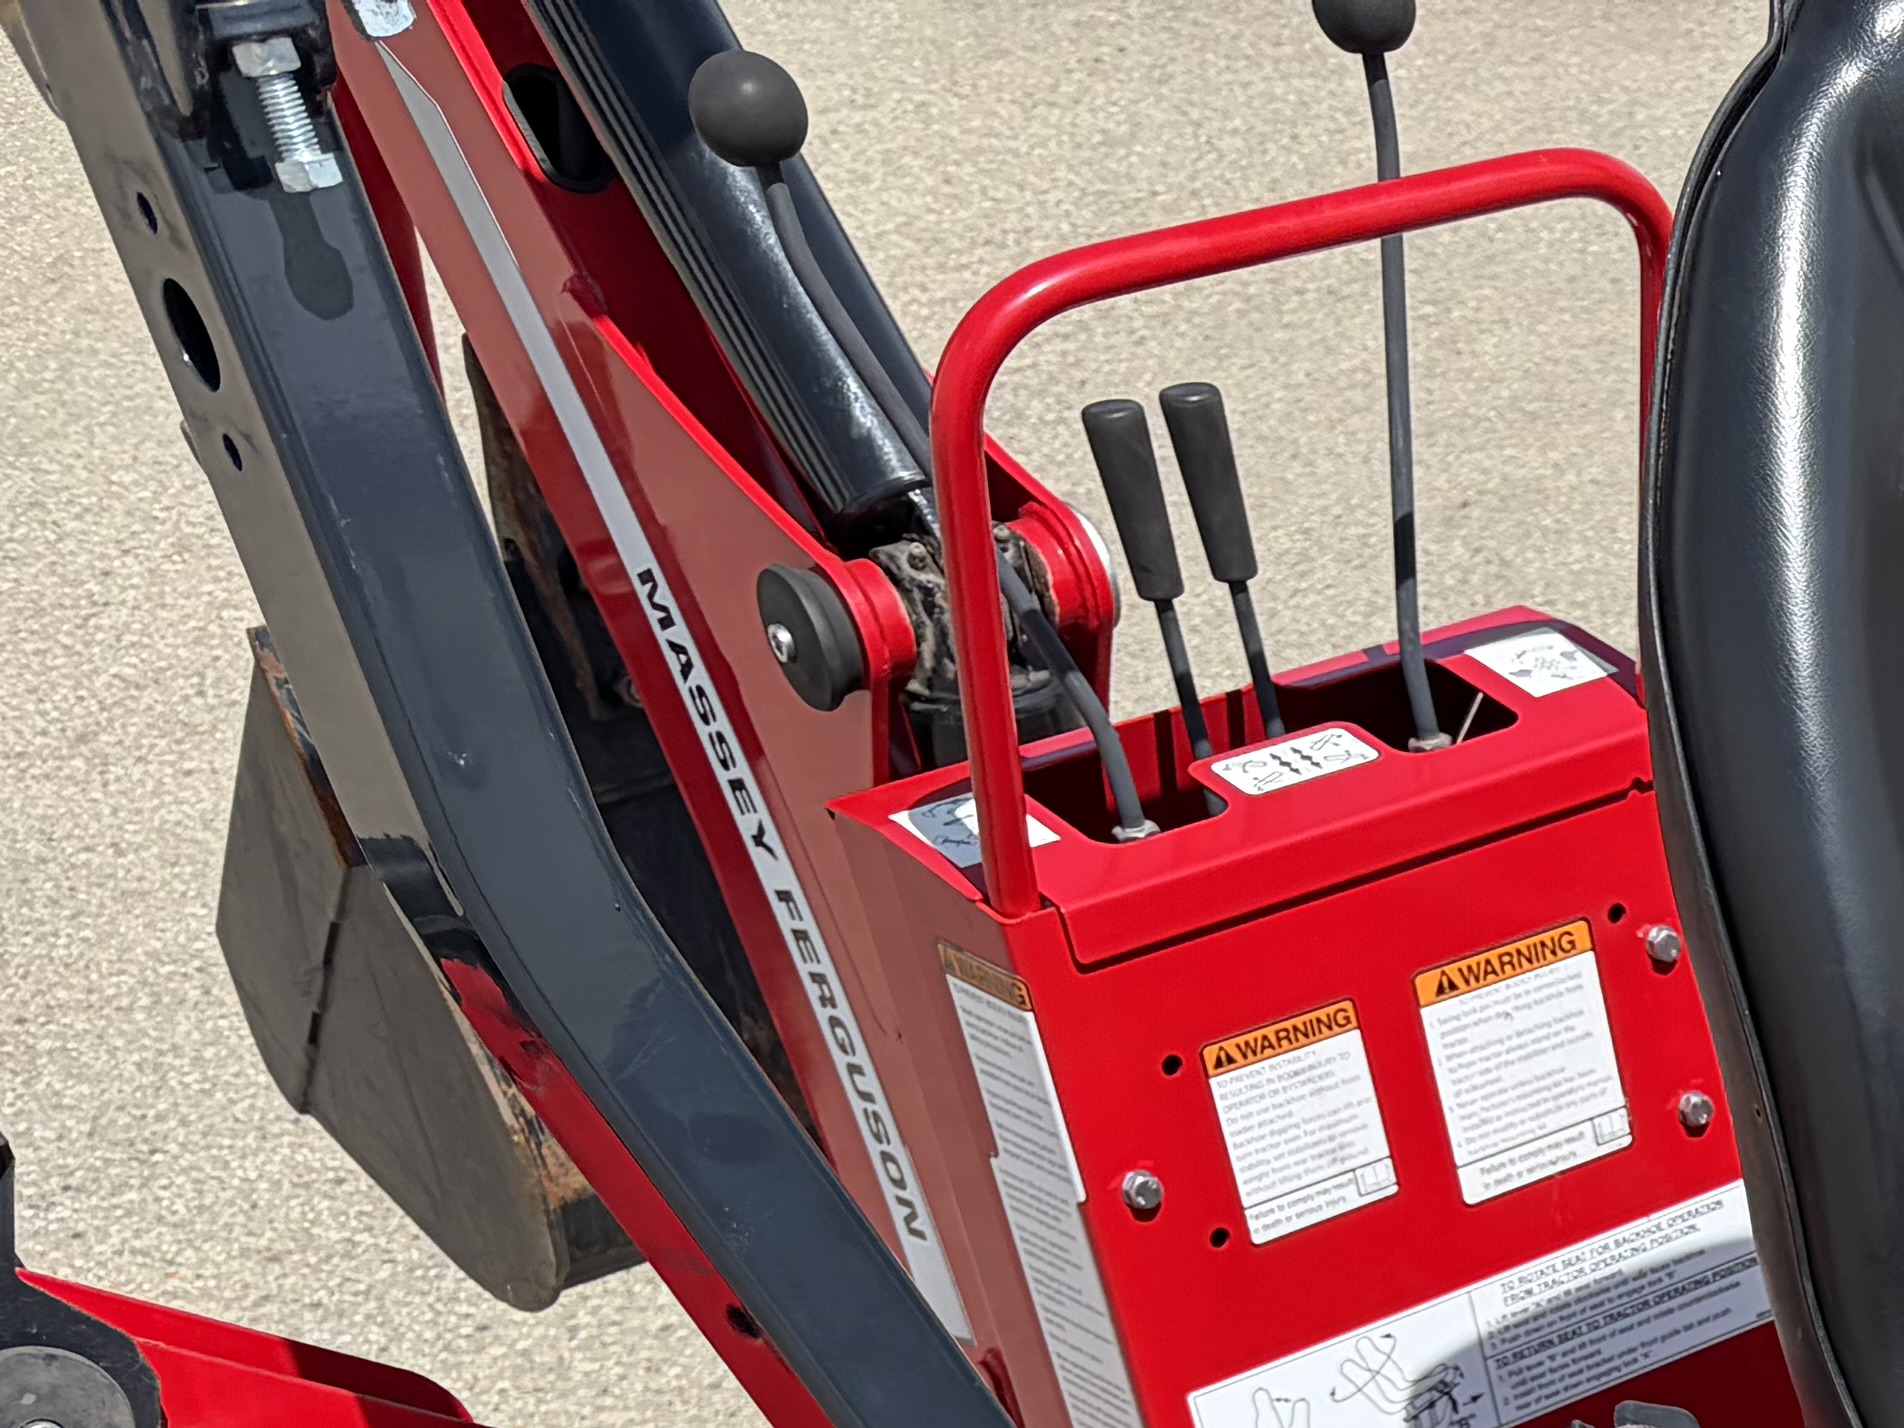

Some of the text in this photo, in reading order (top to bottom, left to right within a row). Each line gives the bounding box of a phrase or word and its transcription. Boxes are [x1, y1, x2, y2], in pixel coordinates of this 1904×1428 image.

[638, 568, 927, 1242] MASSEY FERGUSON
[1457, 928, 1577, 989] WARNING
[1235, 1006, 1352, 1061] WARNING
